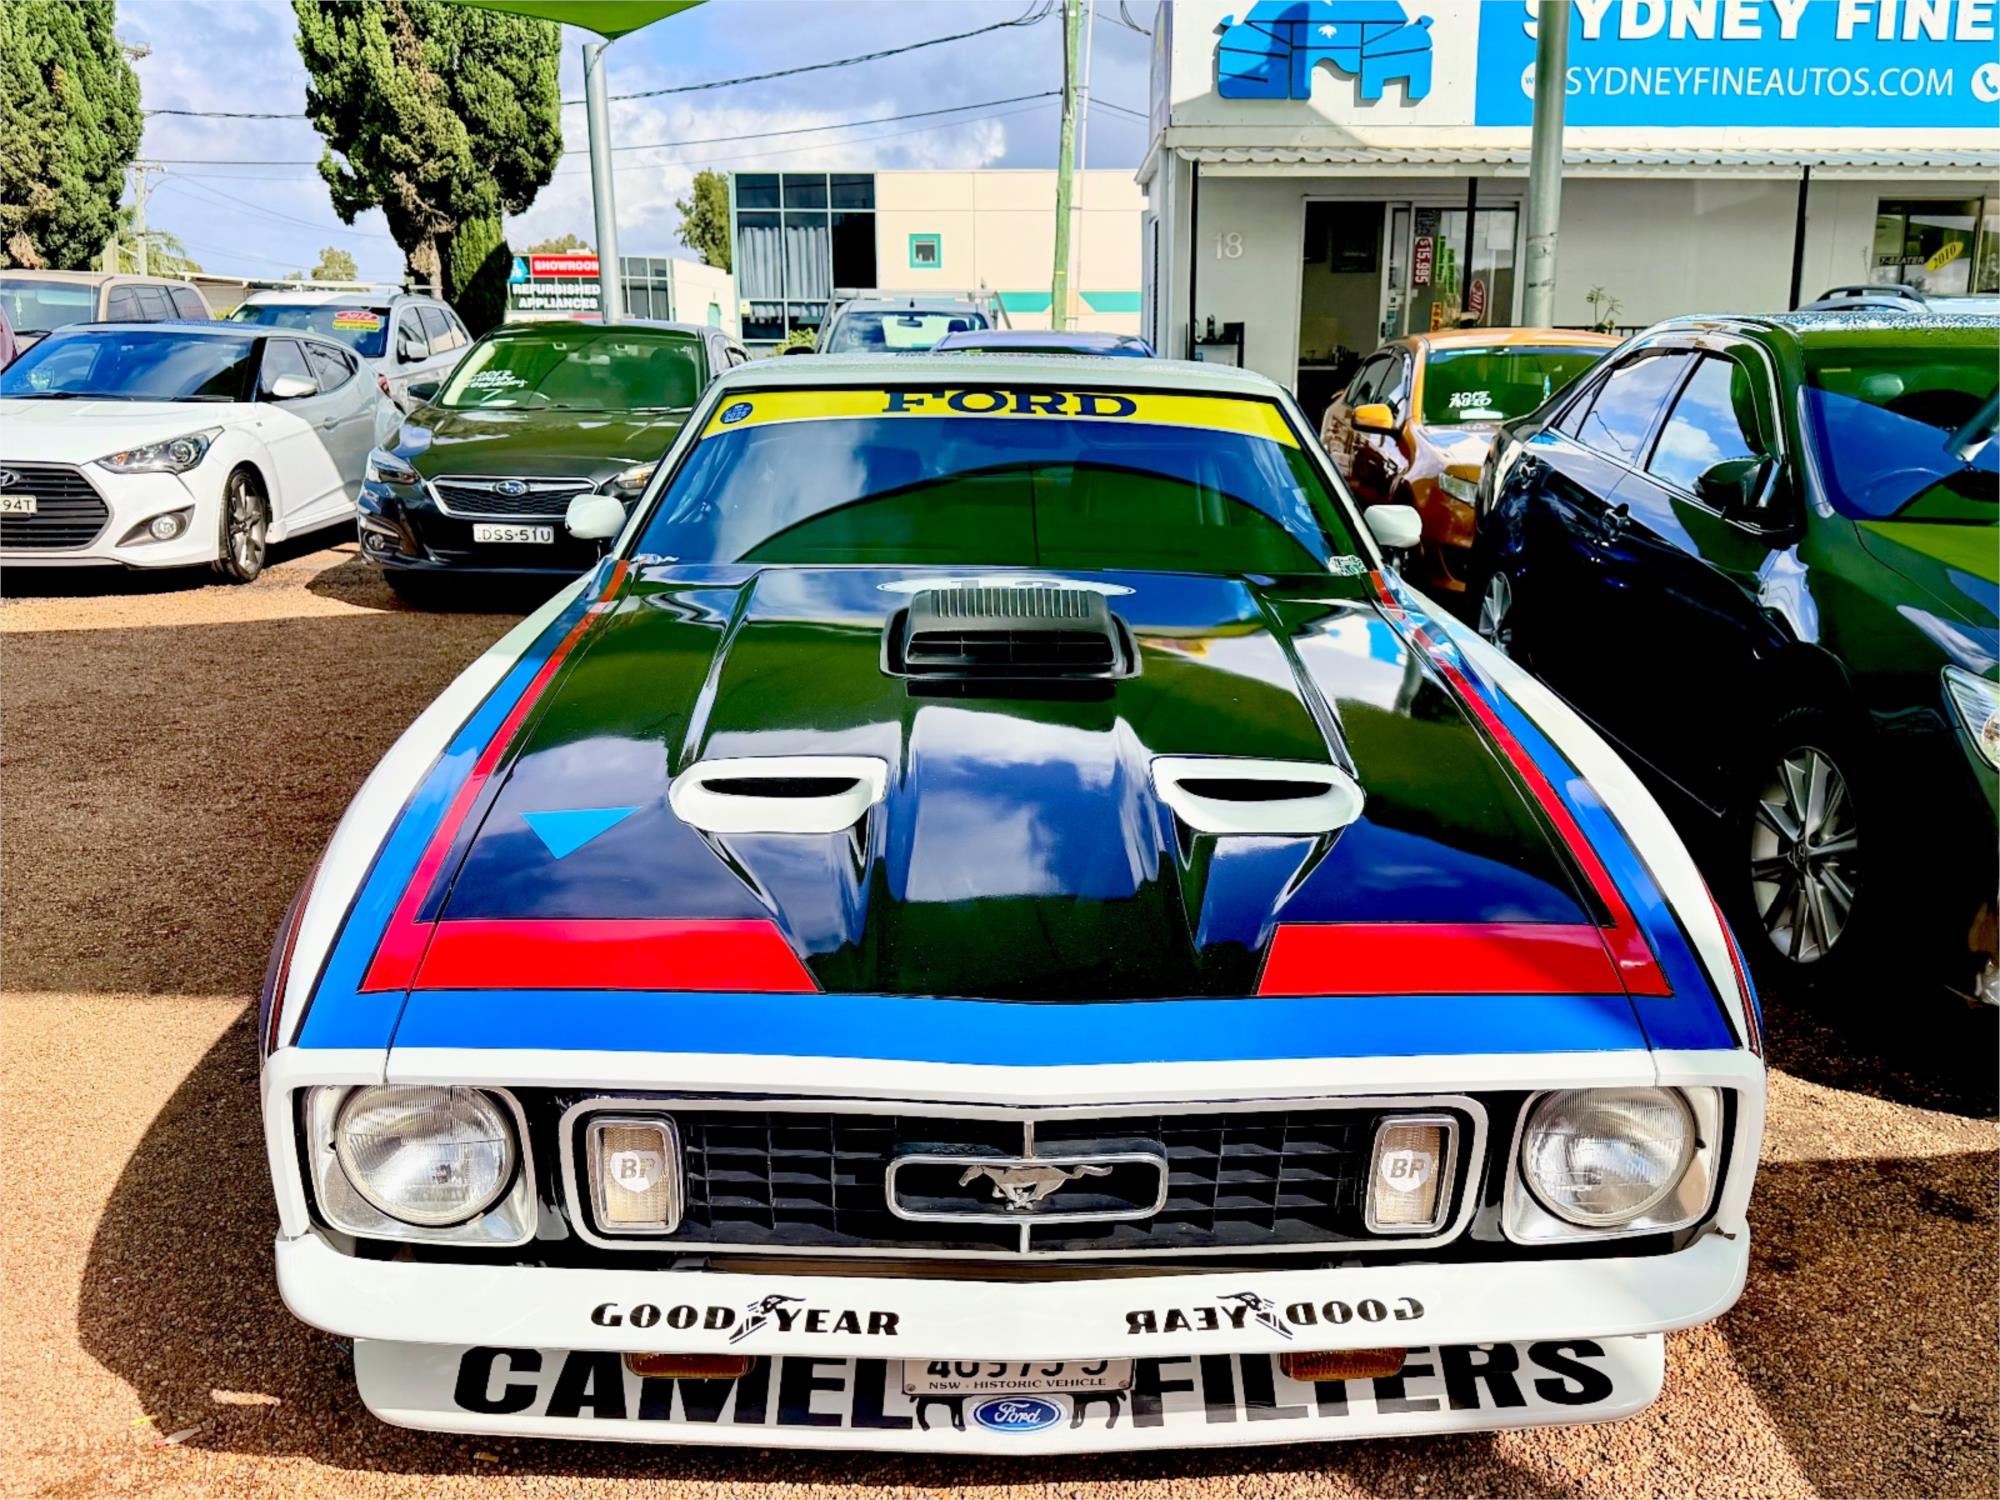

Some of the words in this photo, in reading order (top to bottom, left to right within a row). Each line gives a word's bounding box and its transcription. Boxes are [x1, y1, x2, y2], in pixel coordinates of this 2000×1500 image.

[1523, 0, 1810, 41] YDNEY
[1835, 0, 1996, 42] FINE
[1565, 66, 1954, 97] SYDNEYFINEAUTOS.COM
[1212, 231, 1243, 259] 18
[1414, 239, 1432, 284] $15,995
[512, 284, 601, 295] REFURBISHED
[519, 298, 598, 308] APPLIANCES
[882, 388, 1137, 417] FORD
[2, 499, 32, 511] 94T
[620, 1158, 656, 1179] BP
[1389, 1158, 1426, 1178] BP
[453, 1345, 914, 1428] CAMEL
[928, 1380, 961, 1390] NSW
[973, 1379, 1043, 1389] HISTORIC
[1046, 1377, 1106, 1387] VEHICLE
[994, 1403, 1042, 1424] Ford
